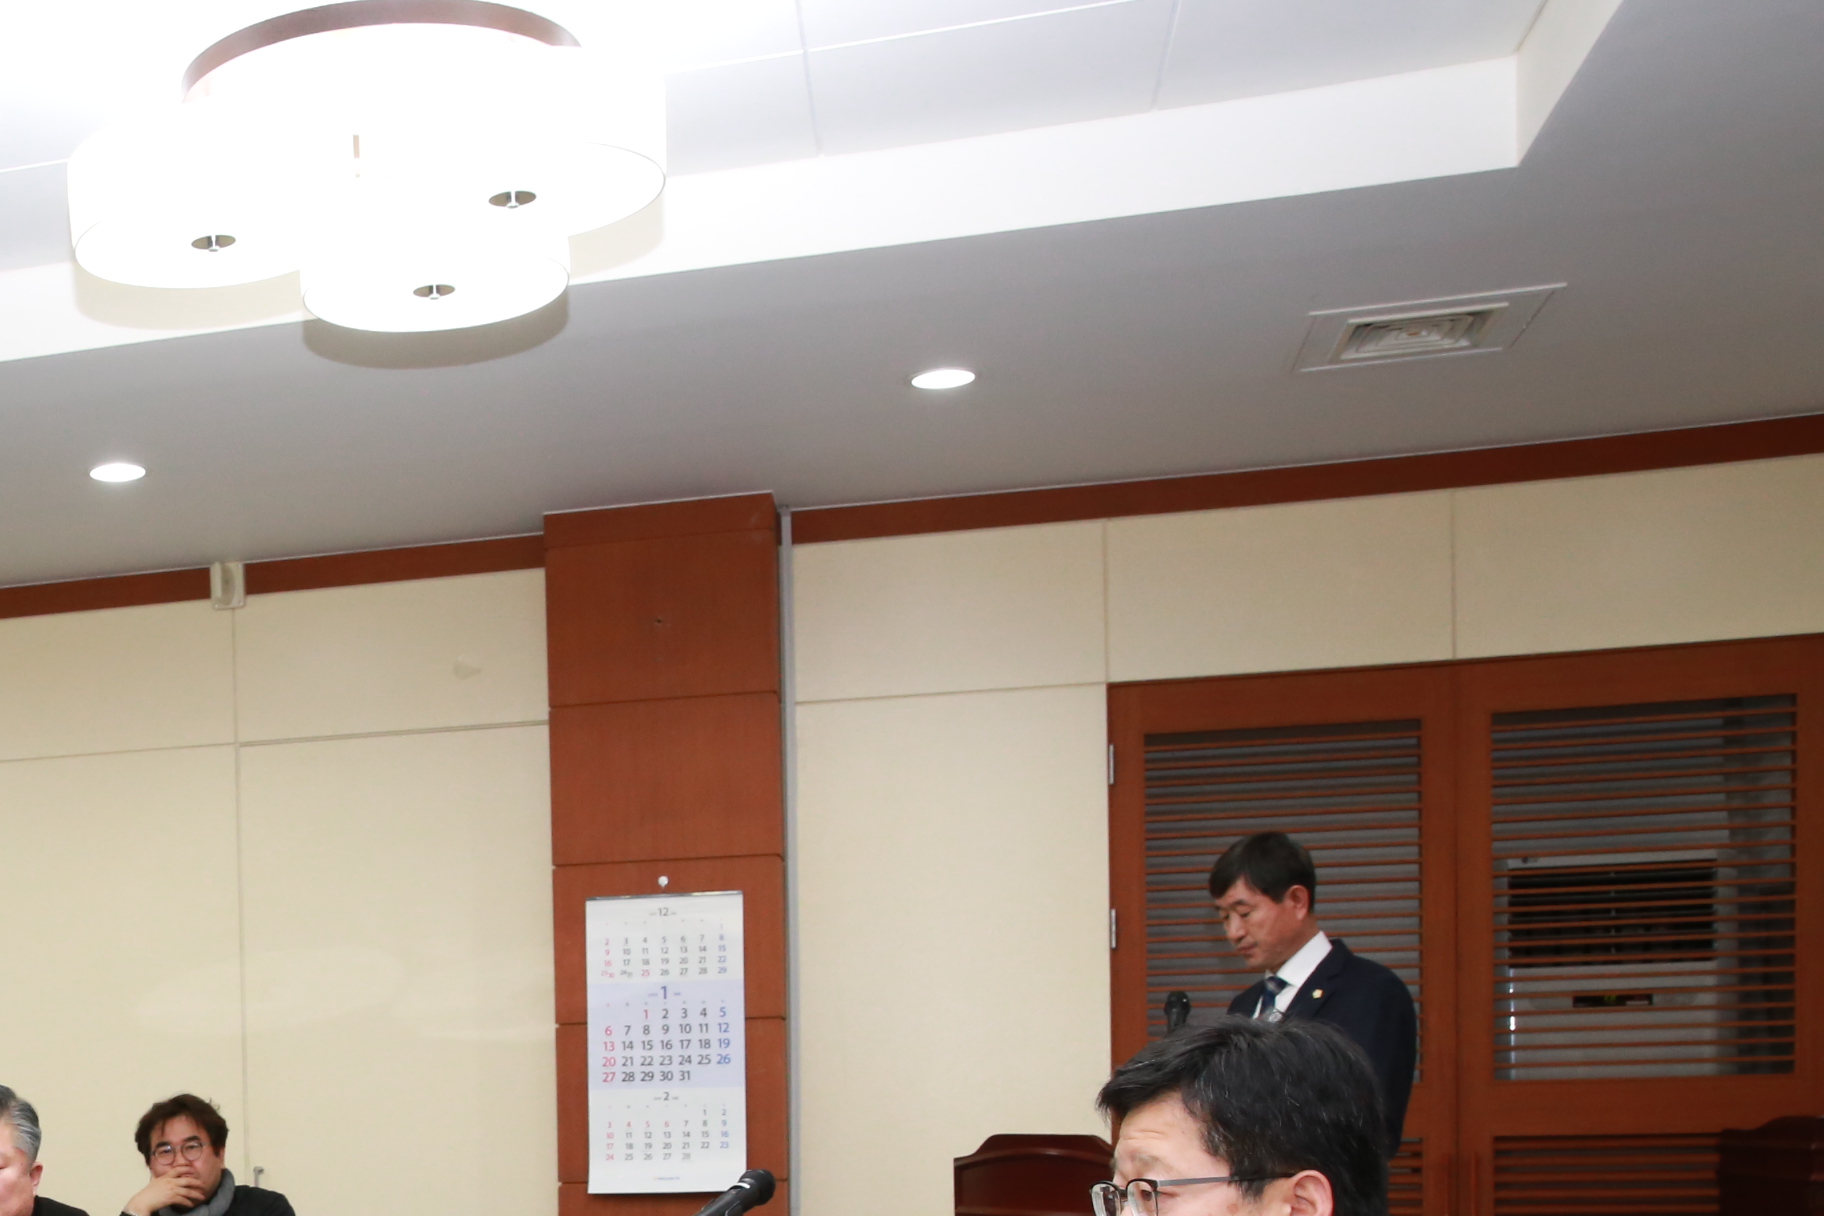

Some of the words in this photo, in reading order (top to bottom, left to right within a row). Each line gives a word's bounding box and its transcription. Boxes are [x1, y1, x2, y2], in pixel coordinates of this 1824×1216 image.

[658, 907, 669, 917] 12
[661, 985, 667, 1000] 1
[643, 1009, 648, 1020] 1
[662, 1008, 669, 1019] 2
[681, 1008, 688, 1019] 3
[700, 1007, 707, 1018] 4
[719, 1006, 727, 1018] 5
[604, 1025, 613, 1036] 6
[624, 1025, 631, 1036] 7
[643, 1024, 650, 1035] 8
[662, 1024, 670, 1035] 9
[679, 1023, 692, 1034] 10
[699, 1023, 709, 1033] 11
[718, 1022, 730, 1033] 12
[603, 1041, 615, 1052] 13
[622, 1040, 634, 1051] 14
[641, 1040, 654, 1051] 15
[660, 1039, 673, 1050] 16
[679, 1039, 691, 1049] 17
[698, 1038, 711, 1049] 18
[718, 1038, 730, 1049] 19
[602, 1056, 616, 1067] 20
[621, 1056, 634, 1067] 21
[640, 1056, 654, 1066] 22
[659, 1055, 673, 1066] 23
[679, 1055, 692, 1065] 24
[697, 1054, 712, 1065] 25
[716, 1054, 731, 1065] 26
[602, 1071, 616, 1083] 27
[621, 1071, 635, 1082] 28
[640, 1071, 654, 1082] 29
[660, 1070, 674, 1082] 30
[679, 1070, 690, 1081] 31
[663, 1092, 670, 1101] 2
